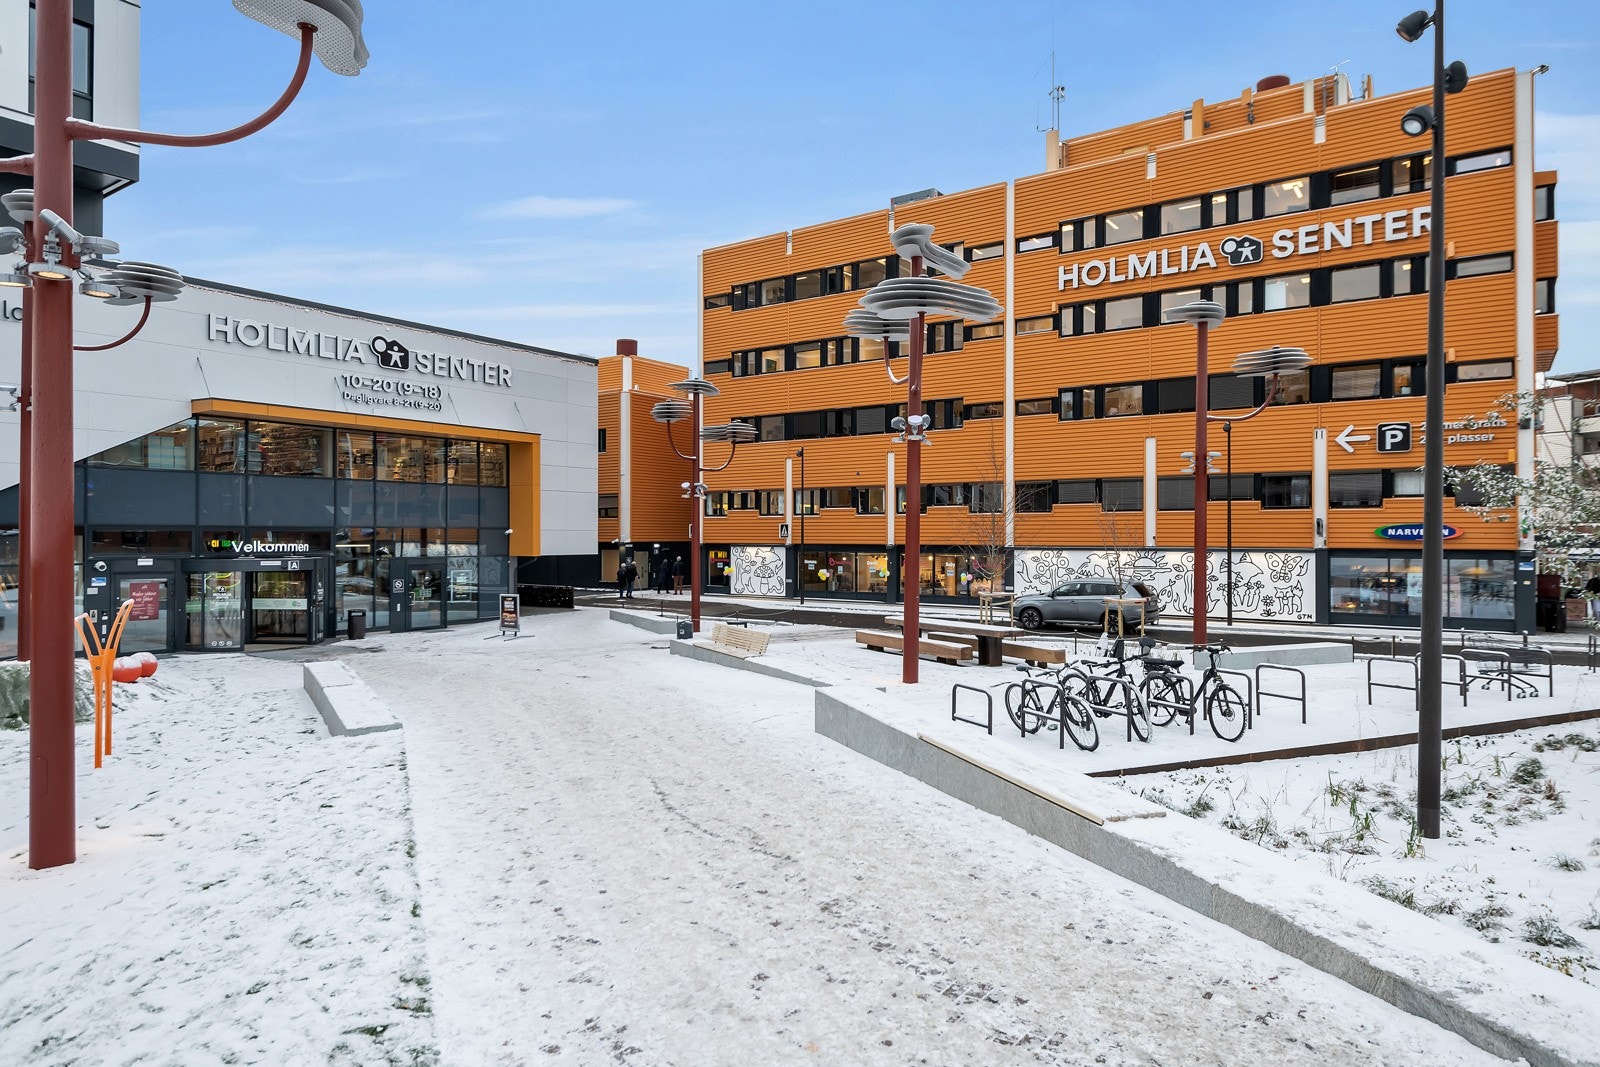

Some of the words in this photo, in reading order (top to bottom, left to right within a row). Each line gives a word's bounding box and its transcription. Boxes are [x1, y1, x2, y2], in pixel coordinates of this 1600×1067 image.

[1058, 241, 1218, 291] HOLMLIA
[1271, 206, 1433, 259] SENTER
[208, 312, 367, 365] HOLMLIA
[415, 349, 513, 388] SENTER
[342, 373, 394, 393] 10-20
[397, 380, 443, 401] (9-18)
[343, 391, 392, 405] Dagligvare
[1385, 430, 1404, 450] P
[1447, 432, 1495, 445] plasser
[1387, 528, 1449, 536] NARVEN
[231, 540, 309, 553] Velkommen
